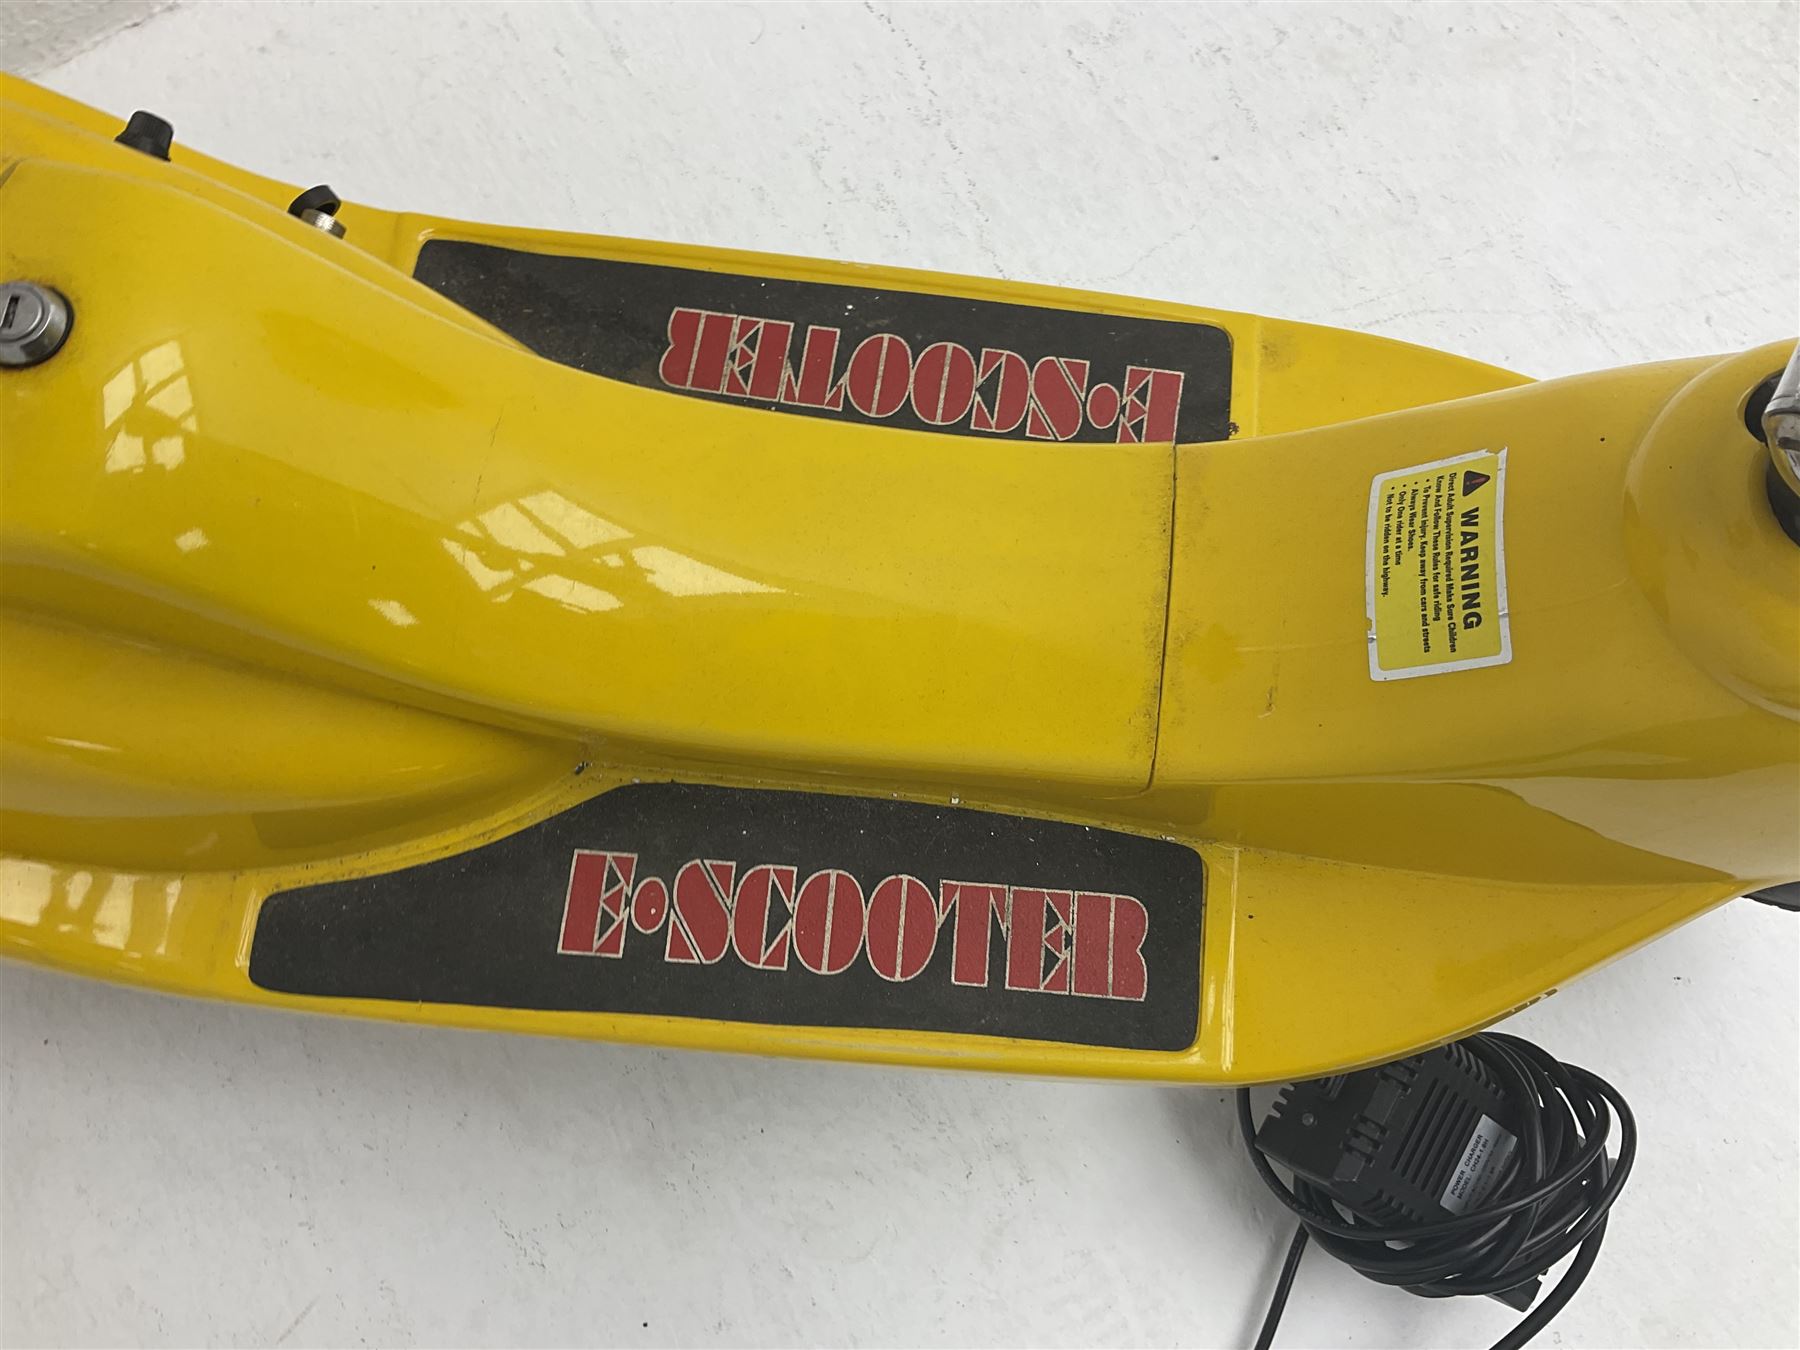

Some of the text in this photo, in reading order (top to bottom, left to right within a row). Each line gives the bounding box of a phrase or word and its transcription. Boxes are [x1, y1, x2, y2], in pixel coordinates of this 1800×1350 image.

[1436, 475, 1444, 492] Know
[1386, 494, 1394, 505] Not
[1397, 491, 1406, 505] Only
[1434, 495, 1443, 507] And
[1397, 506, 1405, 518] One
[1421, 495, 1430, 518] Prevent
[1385, 514, 1392, 522] be
[1408, 489, 1418, 551] Always Wear Shoes.
[1433, 508, 1442, 530] Follow
[1396, 520, 1404, 535] rider
[1383, 545, 1389, 553] on
[1419, 541, 1428, 557] Keep
[1418, 560, 1426, 576] away
[1432, 552, 1440, 570] Rules
[1444, 472, 1457, 652] Direct Adult Supervision Required Make Sure Children
[1460, 507, 1482, 630] WARNING
[1381, 568, 1390, 597] highway.
[1433, 572, 1441, 582] for
[1420, 579, 1428, 595] from
[1433, 584, 1441, 598] safe
[1433, 601, 1442, 621] riding
[1421, 613, 1430, 626] and
[1423, 628, 1431, 652] streets
[1450, 1170, 1466, 1195] POWER
[1464, 1134, 1483, 1167] CHARGER
